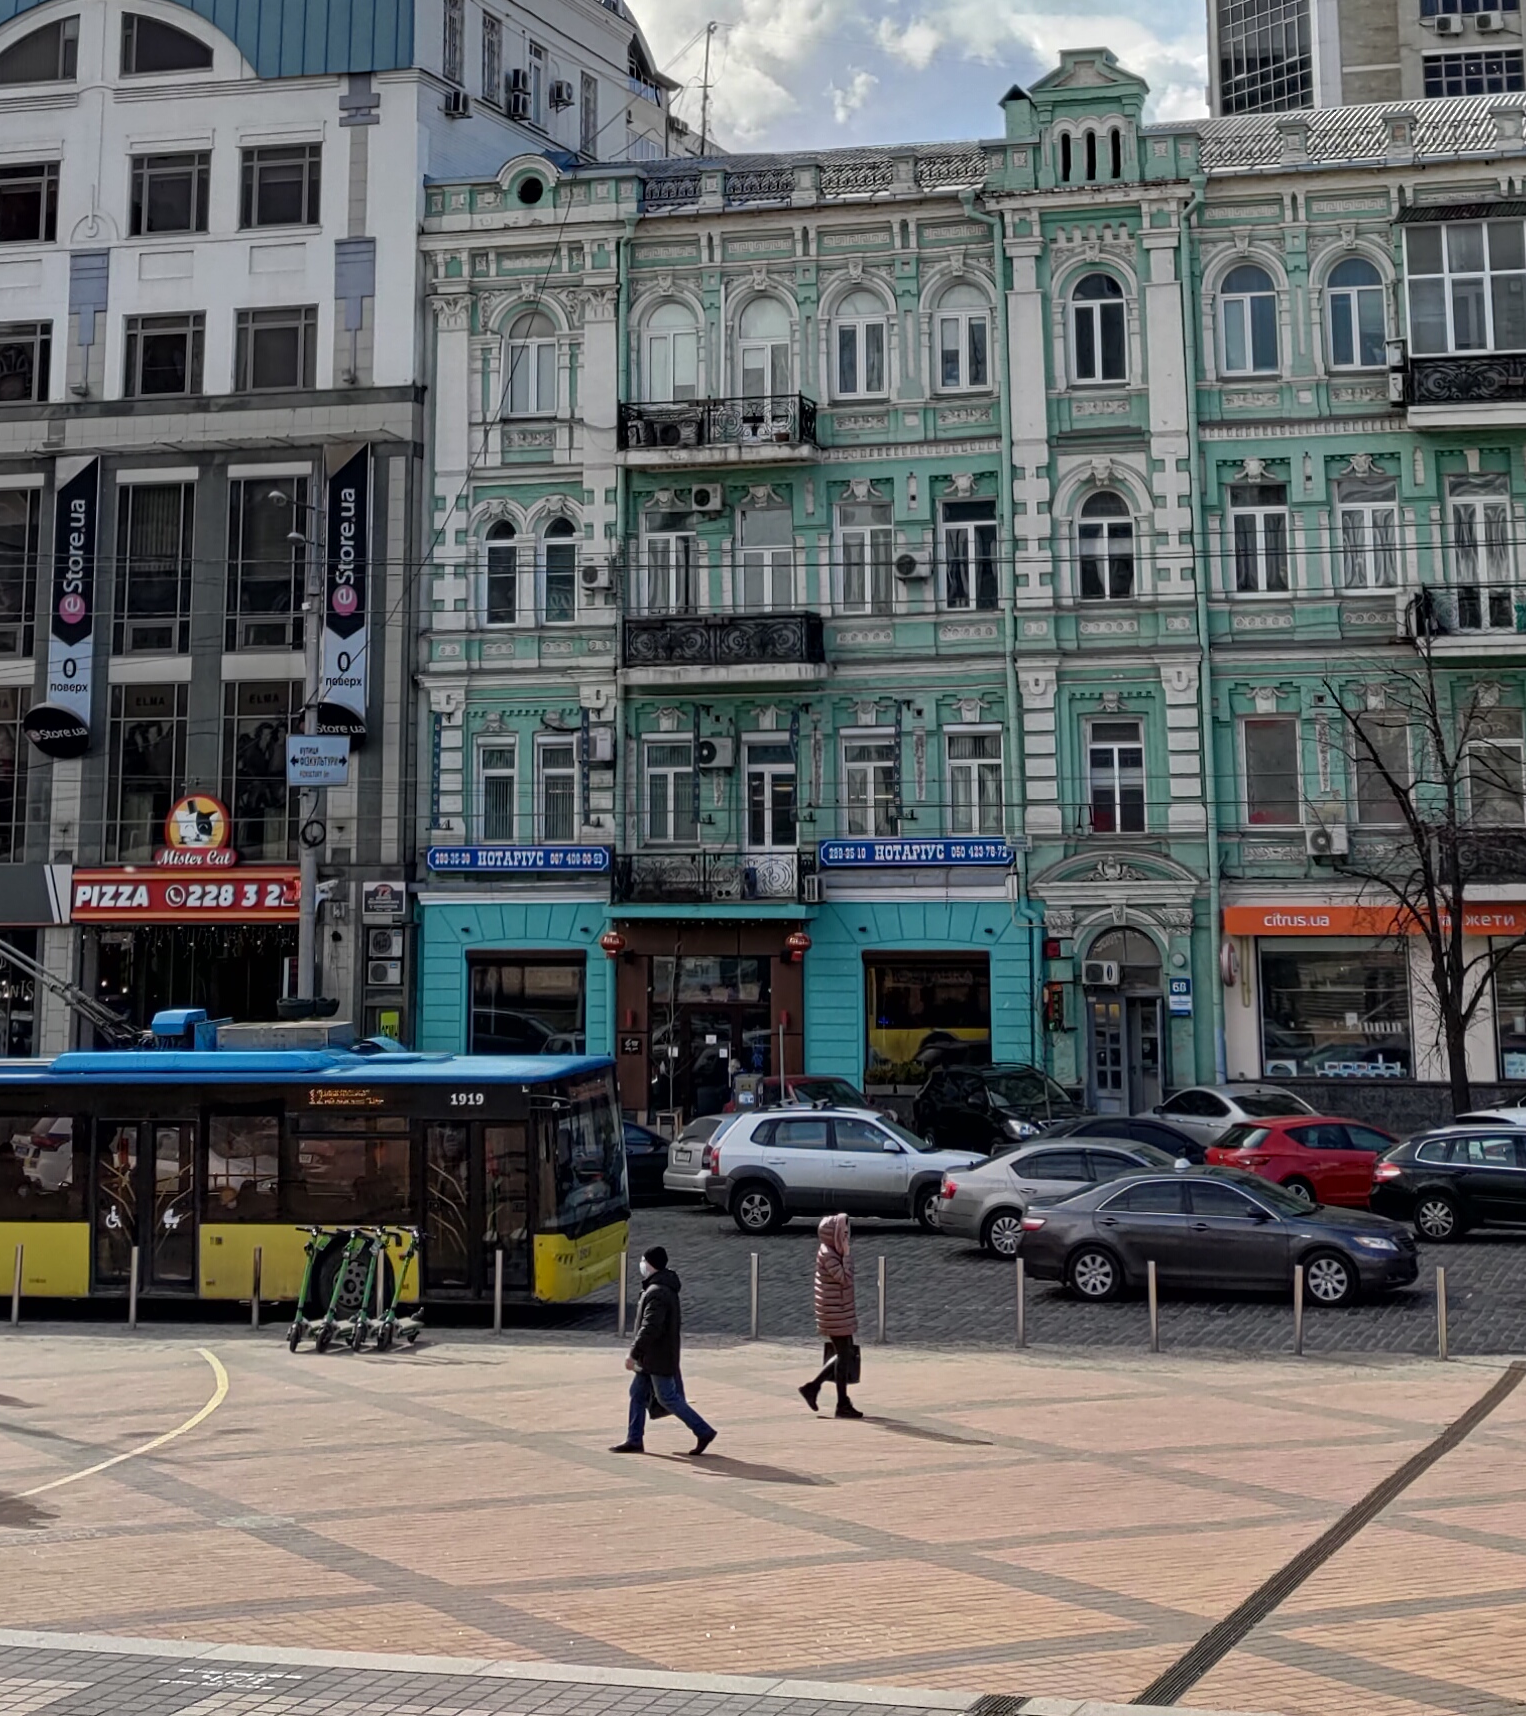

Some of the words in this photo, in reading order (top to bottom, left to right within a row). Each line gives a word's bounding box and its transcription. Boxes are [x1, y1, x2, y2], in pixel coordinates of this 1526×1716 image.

[336, 488, 355, 604] eStore.ua
[63, 499, 86, 613] eStore.ua
[50, 682, 88, 693] поверх
[325, 676, 362, 688] поверх
[136, 696, 165, 707] ELMA
[249, 693, 279, 704] ELMA
[157, 848, 203, 866] Mister
[206, 848, 231, 866] Cat
[477, 851, 544, 866] НОТАРІУС
[875, 844, 945, 860] НОТАРІУС
[75, 885, 149, 908] PIZZA
[186, 884, 235, 908] 228
[241, 884, 259, 908] 3
[1264, 912, 1330, 927] citrus.ua
[450, 1093, 484, 1105] 1919
